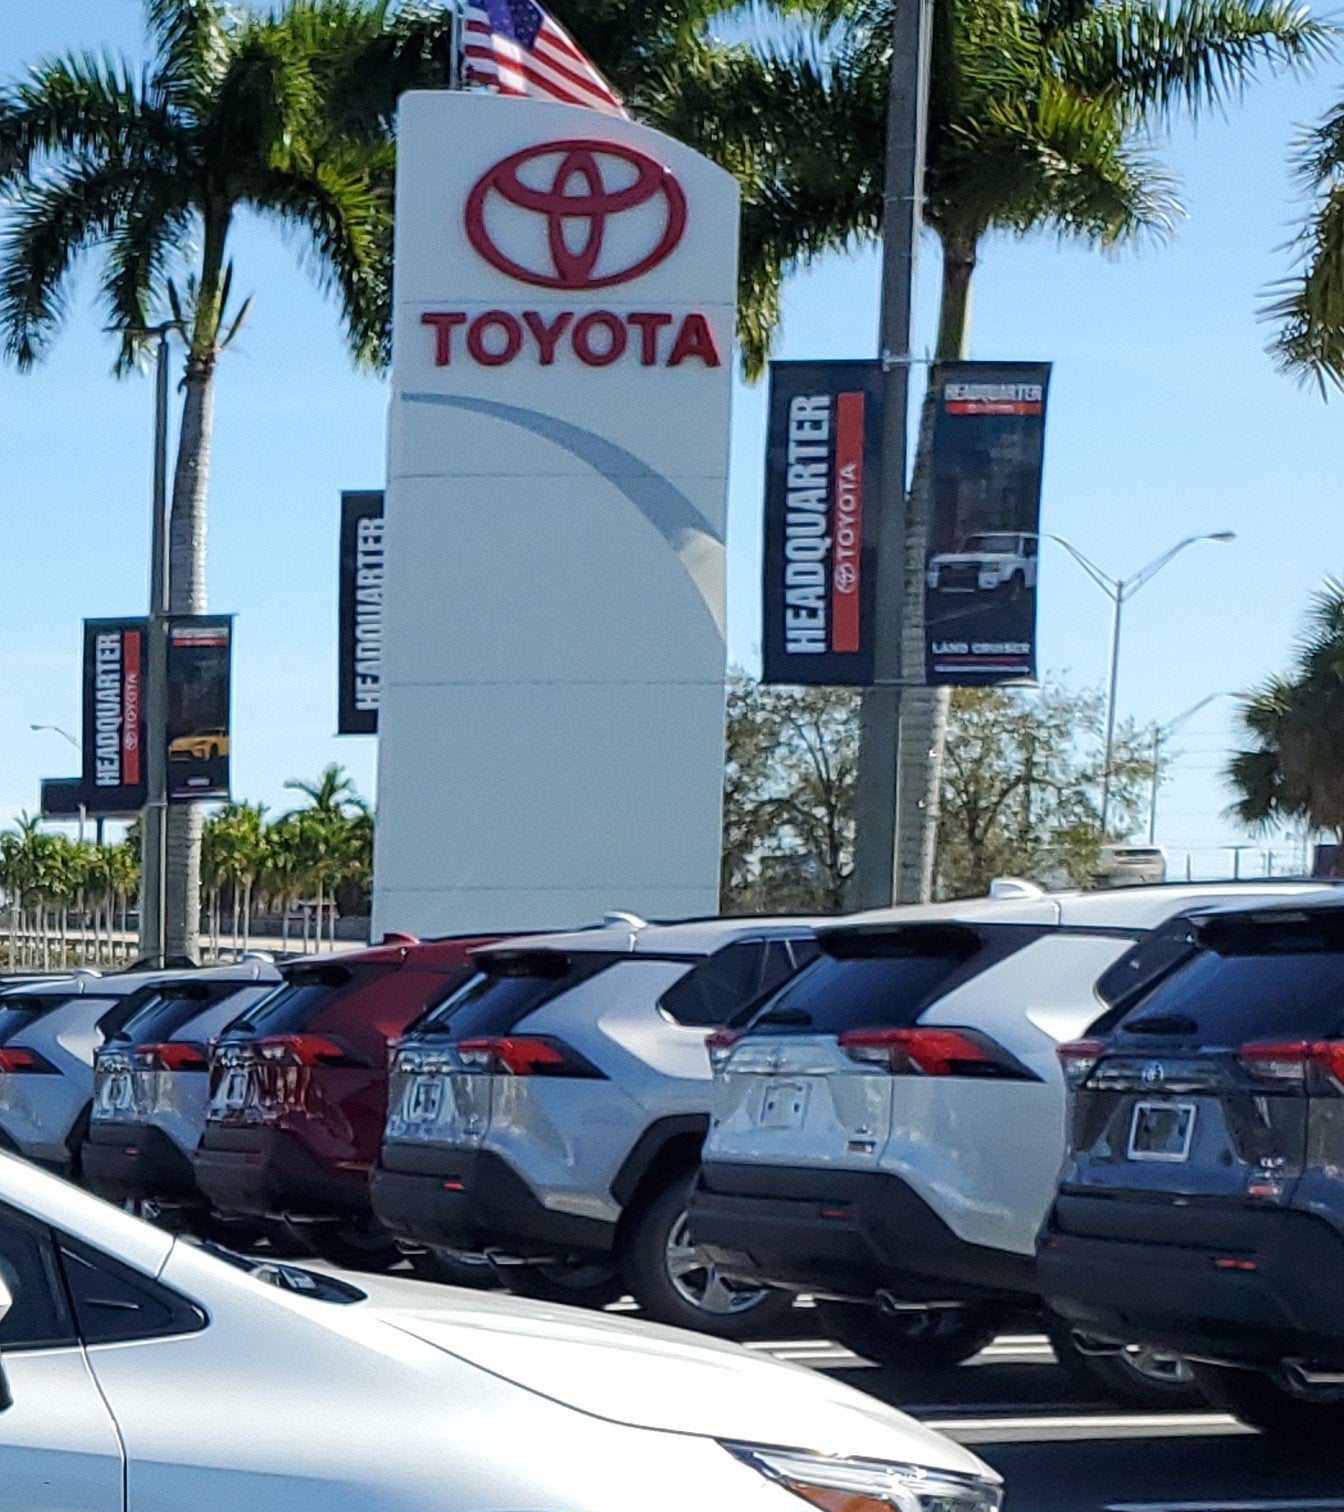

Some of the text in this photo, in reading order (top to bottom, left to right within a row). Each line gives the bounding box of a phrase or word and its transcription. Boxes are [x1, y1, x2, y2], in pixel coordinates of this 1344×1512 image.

[421, 309, 721, 367] TOYOTA
[785, 395, 832, 654] HEADQUARTER
[836, 462, 859, 558] TOYOTA
[95, 634, 123, 787] HEADQUARTER
